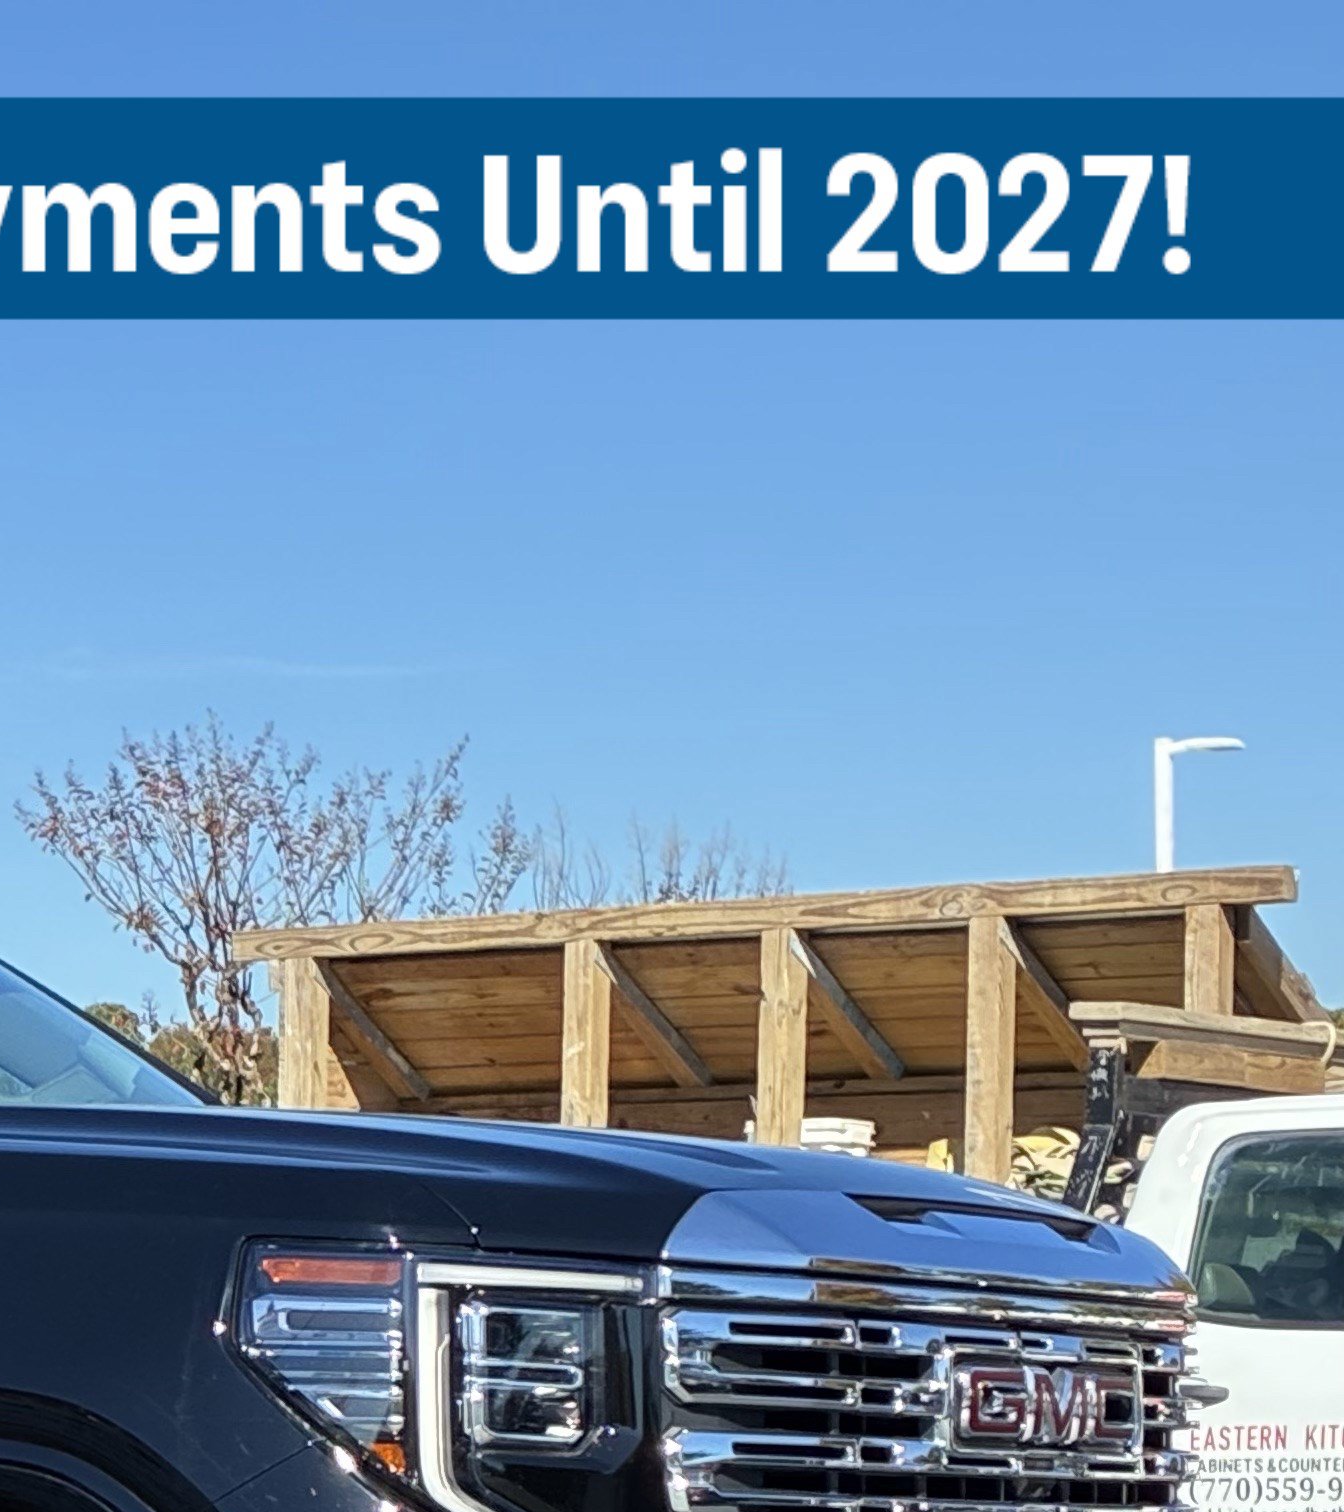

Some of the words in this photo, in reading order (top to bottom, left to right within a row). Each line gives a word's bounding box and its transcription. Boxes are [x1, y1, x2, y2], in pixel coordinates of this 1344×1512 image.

[960, 1365, 1136, 1445] GMC
[1190, 1424, 1288, 1451] EASTERN
[1305, 1424, 1344, 1450] KIT
[1197, 1458, 1264, 1473] ABINETS
[1278, 1458, 1344, 1473] COUNTE
